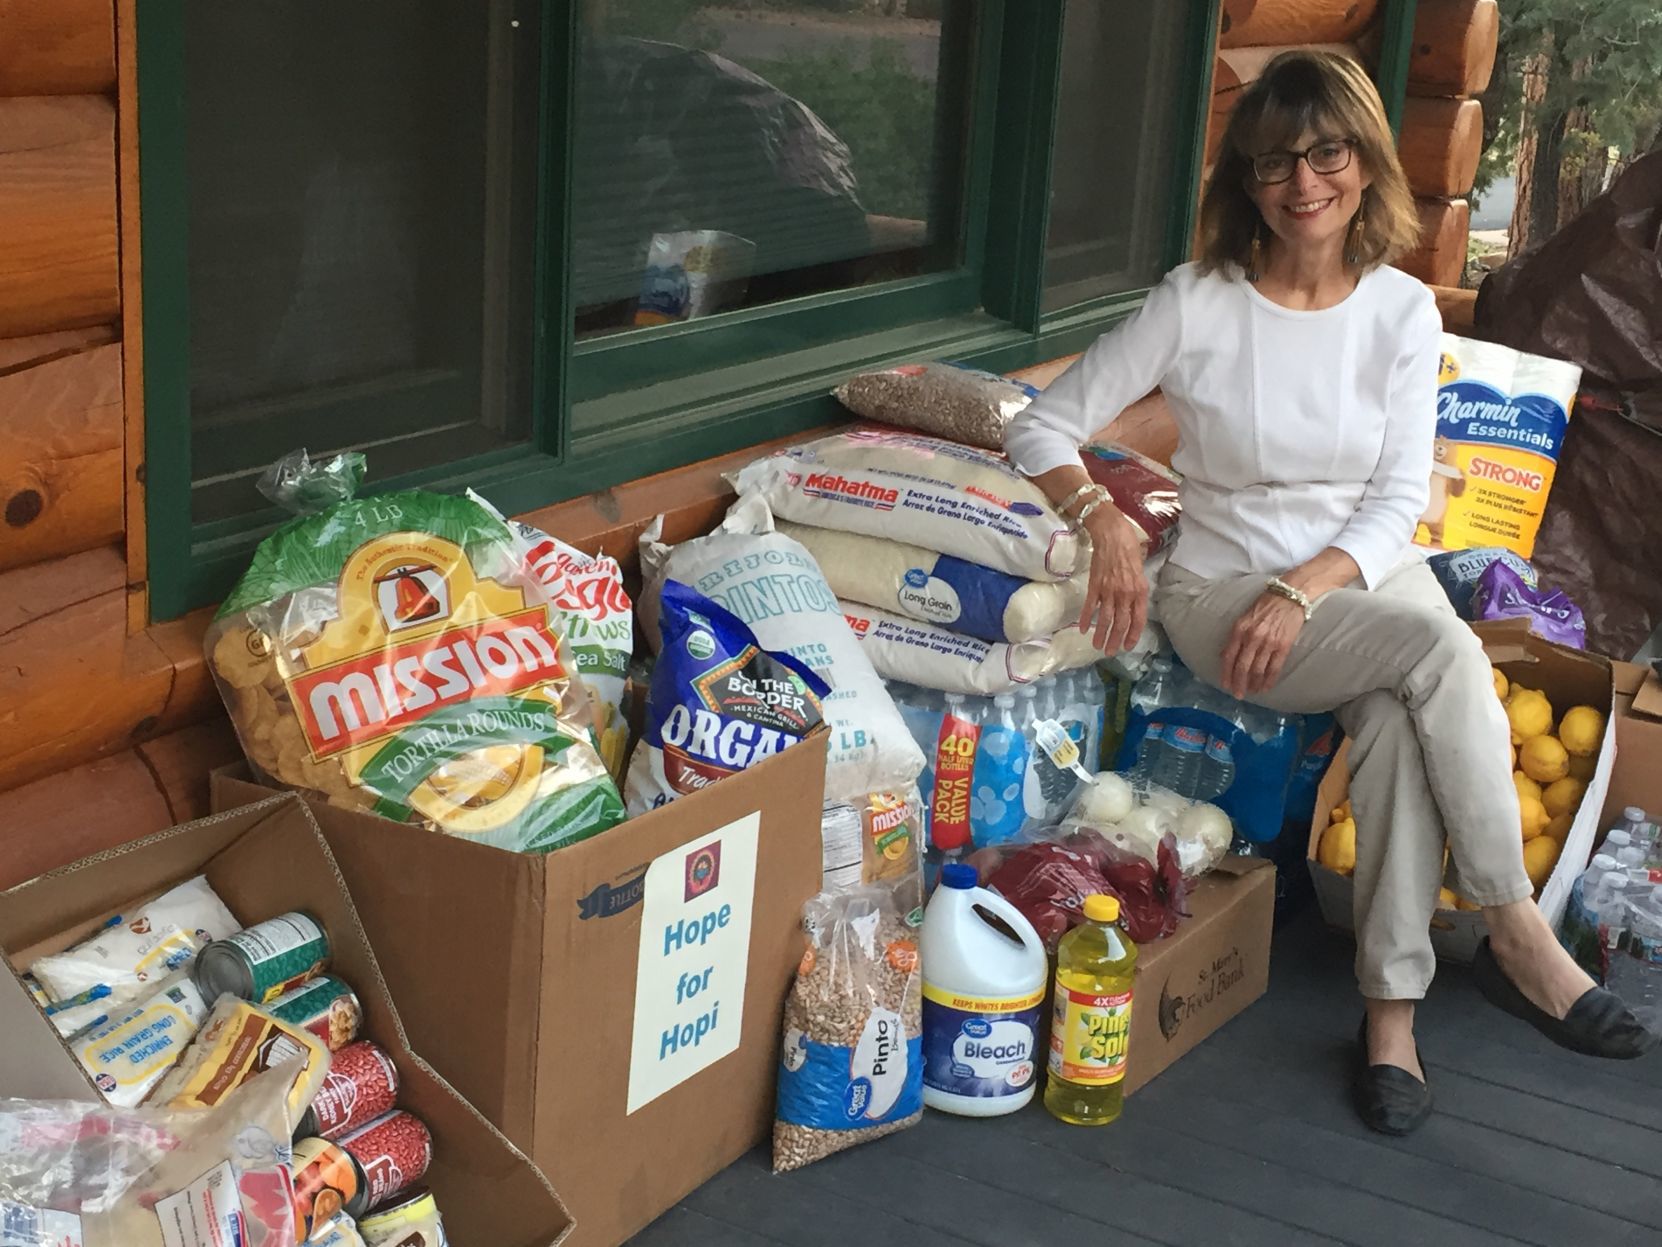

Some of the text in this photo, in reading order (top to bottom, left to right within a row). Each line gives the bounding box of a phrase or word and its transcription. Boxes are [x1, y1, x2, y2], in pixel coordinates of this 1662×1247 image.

[1437, 393, 1519, 427] Charmin
[1467, 422, 1554, 450] Essentials
[1470, 458, 1541, 491] STRONG
[805, 473, 899, 503] Mahatma
[354, 504, 403, 527] 4 LB
[907, 489, 933, 502] Extra
[935, 495, 958, 509] Long
[960, 502, 1002, 520] Enriched
[926, 505, 936, 513] de
[963, 514, 986, 527] Largo
[904, 590, 953, 611] Long Grain
[878, 620, 901, 631] Extra
[904, 627, 927, 639] Long
[929, 631, 968, 647] Enriched
[573, 651, 626, 672] ea Salt
[761, 678, 794, 696] THE
[733, 705, 799, 730] MEXICAN GRILL
[381, 711, 546, 783] TORTILLA ROUNDS
[840, 730, 867, 750] LB
[940, 734, 975, 757] 40
[934, 779, 953, 824] PACK
[950, 777, 969, 825] VALUE
[664, 904, 731, 957] Hope
[677, 966, 714, 1005] for
[952, 998, 974, 1009] KEEPS
[1093, 996, 1110, 1007] 4X
[151, 1015, 177, 1034] LONG
[659, 1001, 719, 1061] Hopi
[122, 1027, 154, 1050] GRAIN
[129, 1035, 174, 1064] ENRICHED
[872, 1019, 889, 1077] Pinto
[964, 1040, 1026, 1060] Bleach
[1092, 1033, 1126, 1059] Sol
[99, 1045, 125, 1063] RICE
